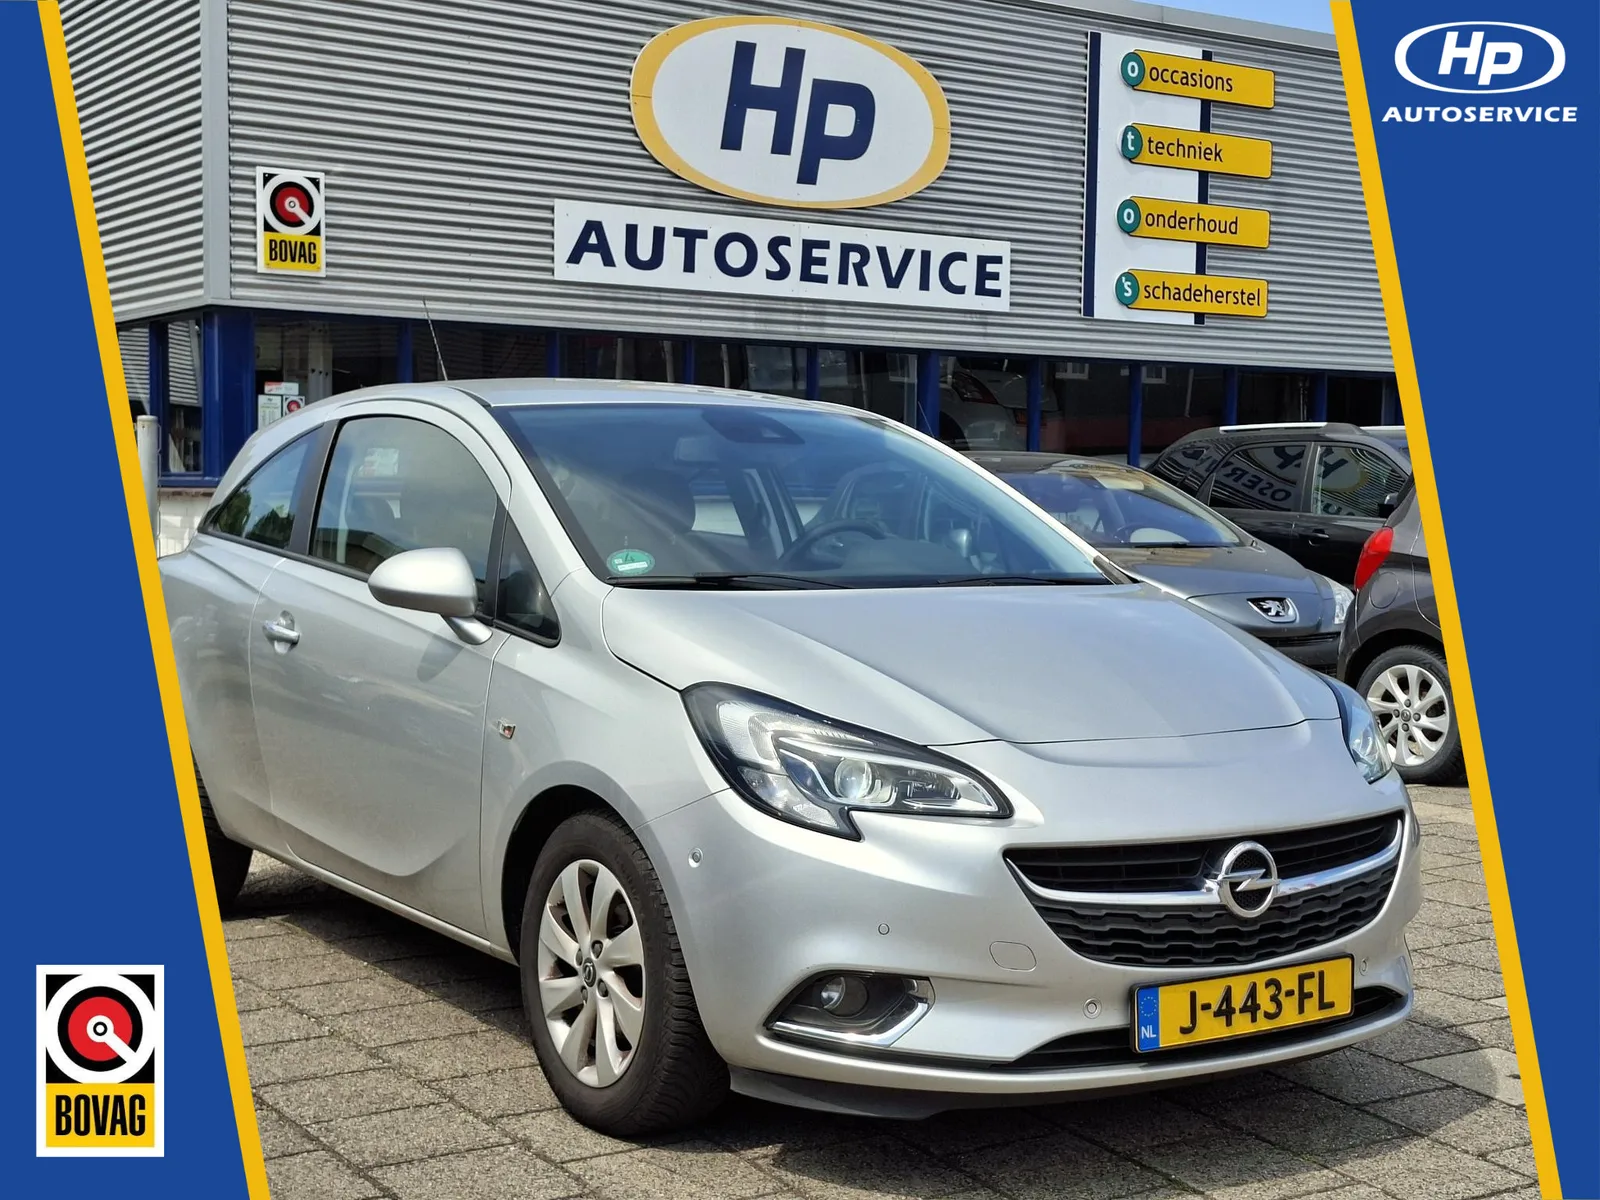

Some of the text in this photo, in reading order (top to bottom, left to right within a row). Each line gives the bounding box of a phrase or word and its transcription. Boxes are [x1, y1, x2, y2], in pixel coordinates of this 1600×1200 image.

[1149, 66, 1234, 93] occasions
[1126, 131, 1224, 163] t techniek
[1144, 209, 1239, 236] onderhoud
[268, 238, 317, 265] BOVAG
[566, 219, 1004, 299] AUTOSERVICE
[1143, 280, 1261, 307] schadeherstel
[1178, 969, 1336, 1036] J-443-FL
[1140, 1025, 1158, 1039] NL
